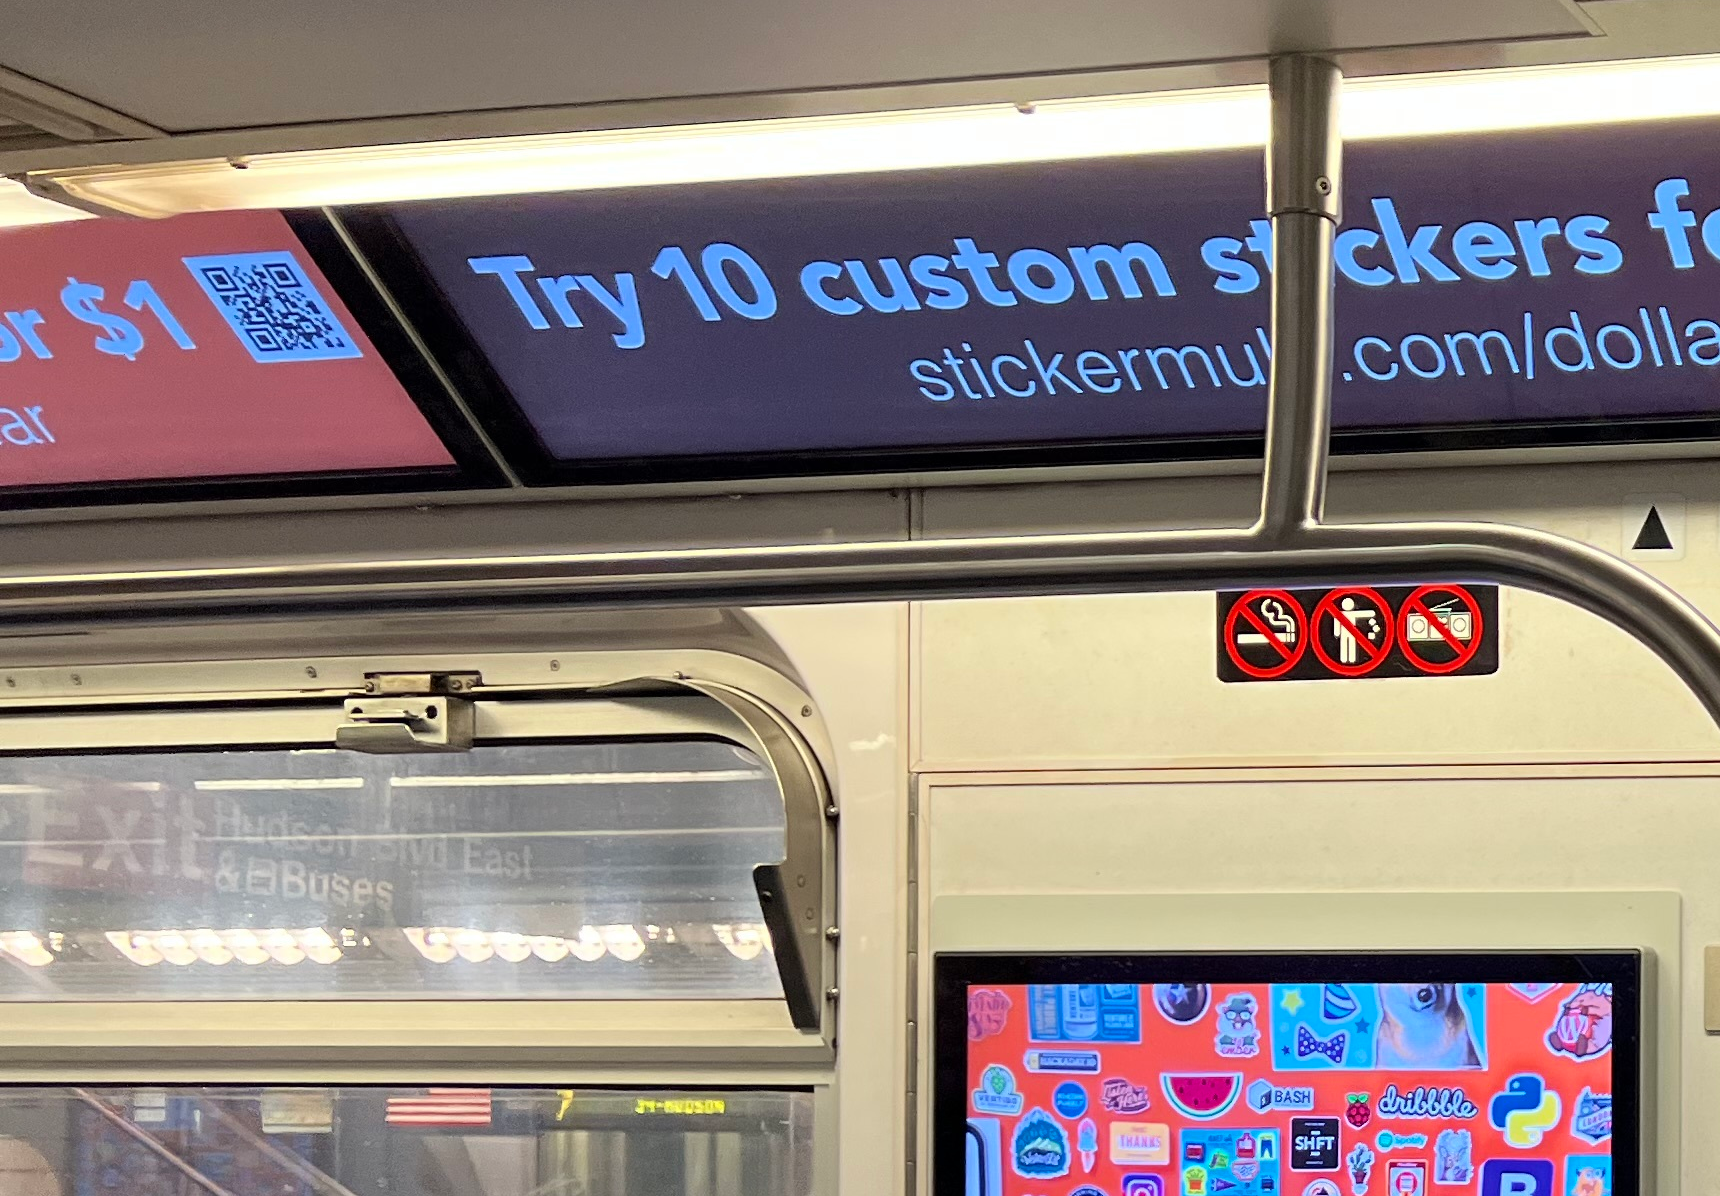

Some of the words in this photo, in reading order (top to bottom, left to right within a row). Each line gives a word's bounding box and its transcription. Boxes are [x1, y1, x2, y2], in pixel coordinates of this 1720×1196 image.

[469, 254, 645, 350] Try
[650, 242, 778, 322] 10
[800, 238, 1178, 317] custom
[1201, 197, 1622, 293] stckers
[60, 275, 197, 362] $1
[280, 860, 395, 911] Buses
[556, 1090, 575, 1121] 7
[1274, 1089, 1311, 1104] BASH
[1378, 1083, 1479, 1119] dribbble
